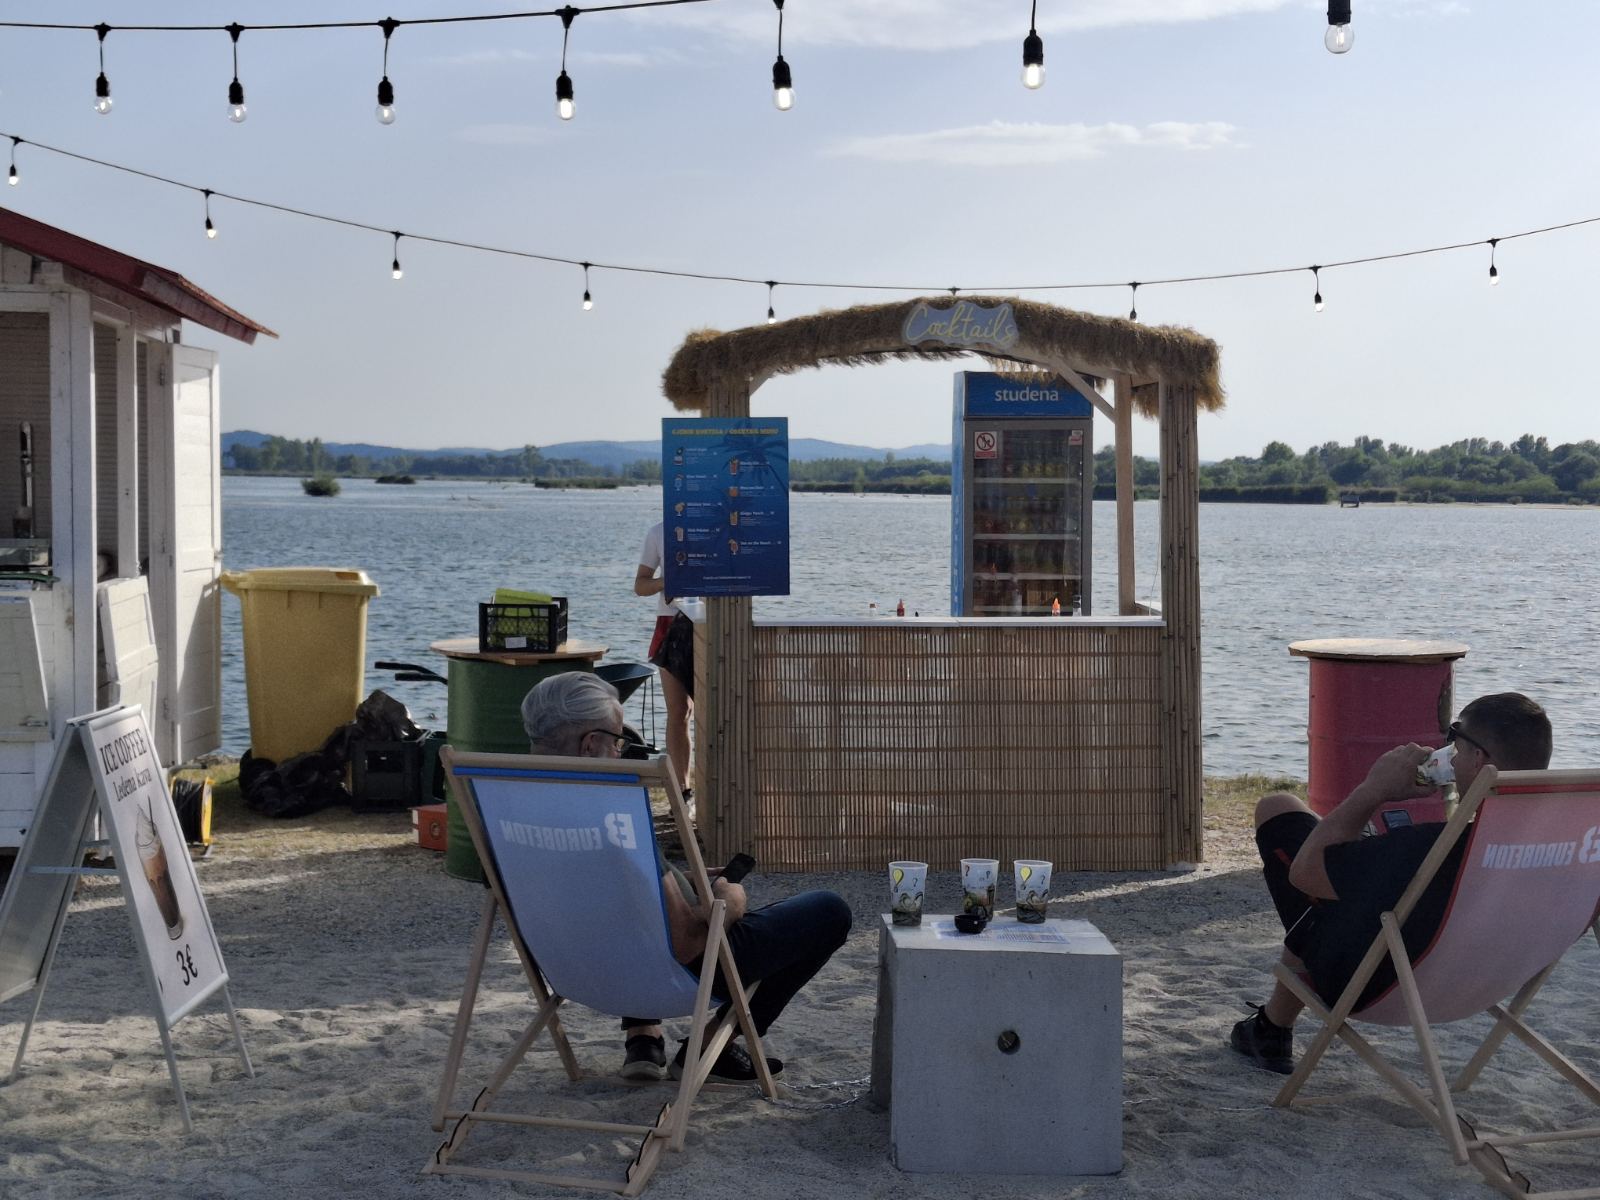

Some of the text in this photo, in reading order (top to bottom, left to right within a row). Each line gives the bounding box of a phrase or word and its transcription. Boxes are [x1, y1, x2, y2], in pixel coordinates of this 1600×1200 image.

[905, 304, 1015, 346] Cocktails
[995, 386, 1059, 402] studena
[99, 728, 147, 776] ICE COFFEE
[113, 775, 138, 802] Ledena
[176, 943, 198, 986] 3€
